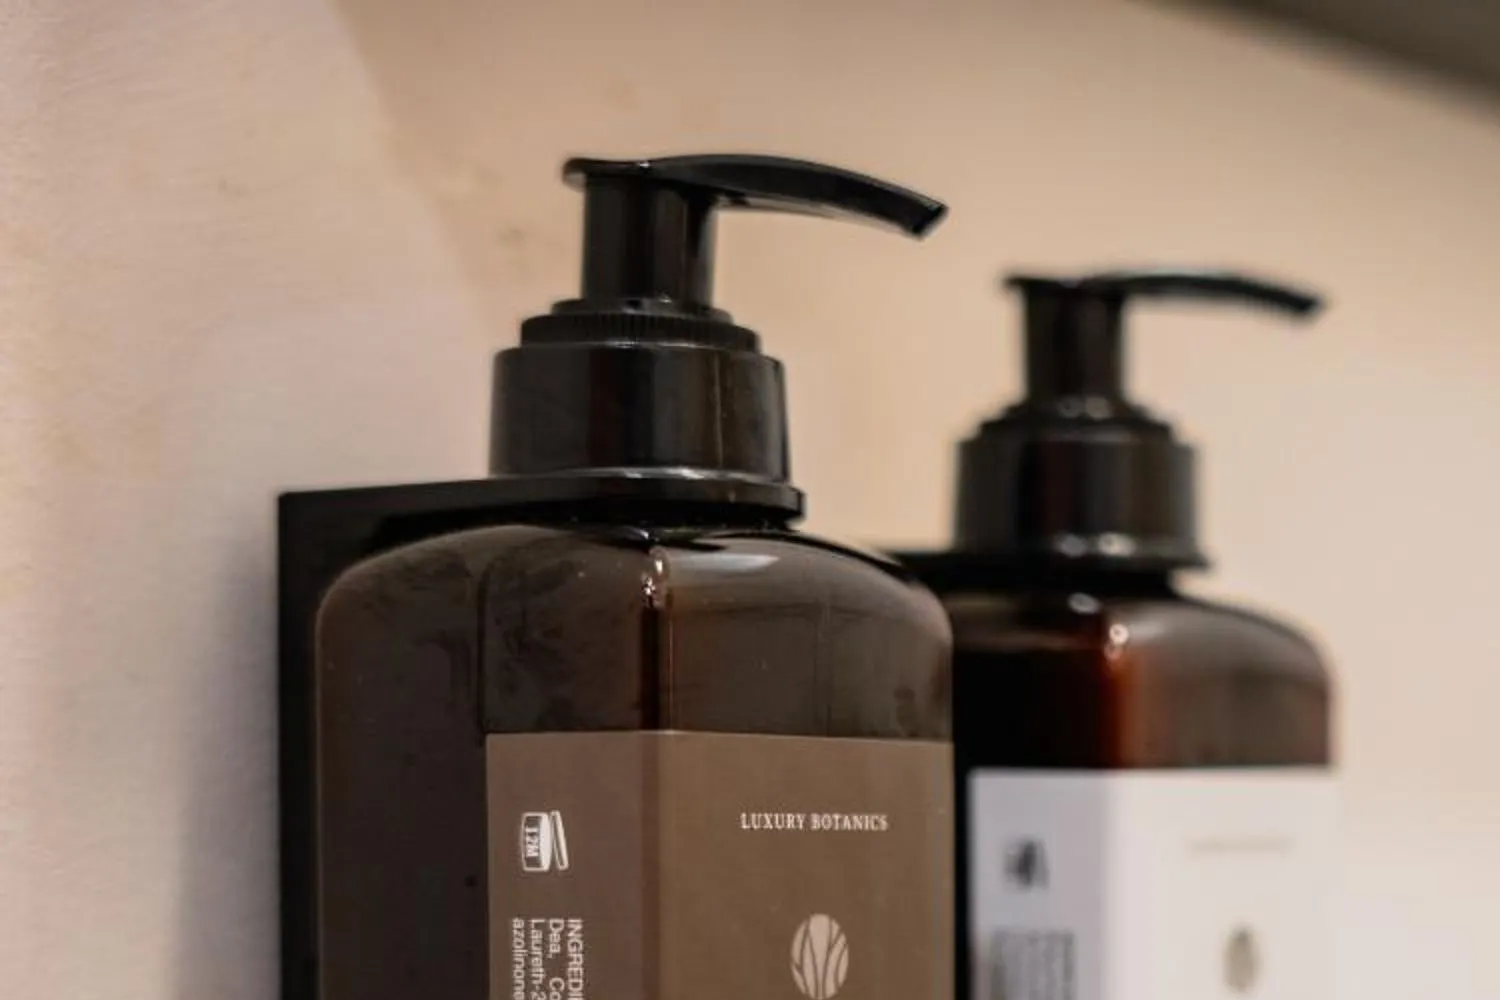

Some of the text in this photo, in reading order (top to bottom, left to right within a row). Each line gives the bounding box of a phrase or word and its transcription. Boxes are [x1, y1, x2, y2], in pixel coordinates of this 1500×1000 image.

[740, 812, 889, 831] LUXURY BOTANICS
[511, 917, 528, 1000] azolinone
